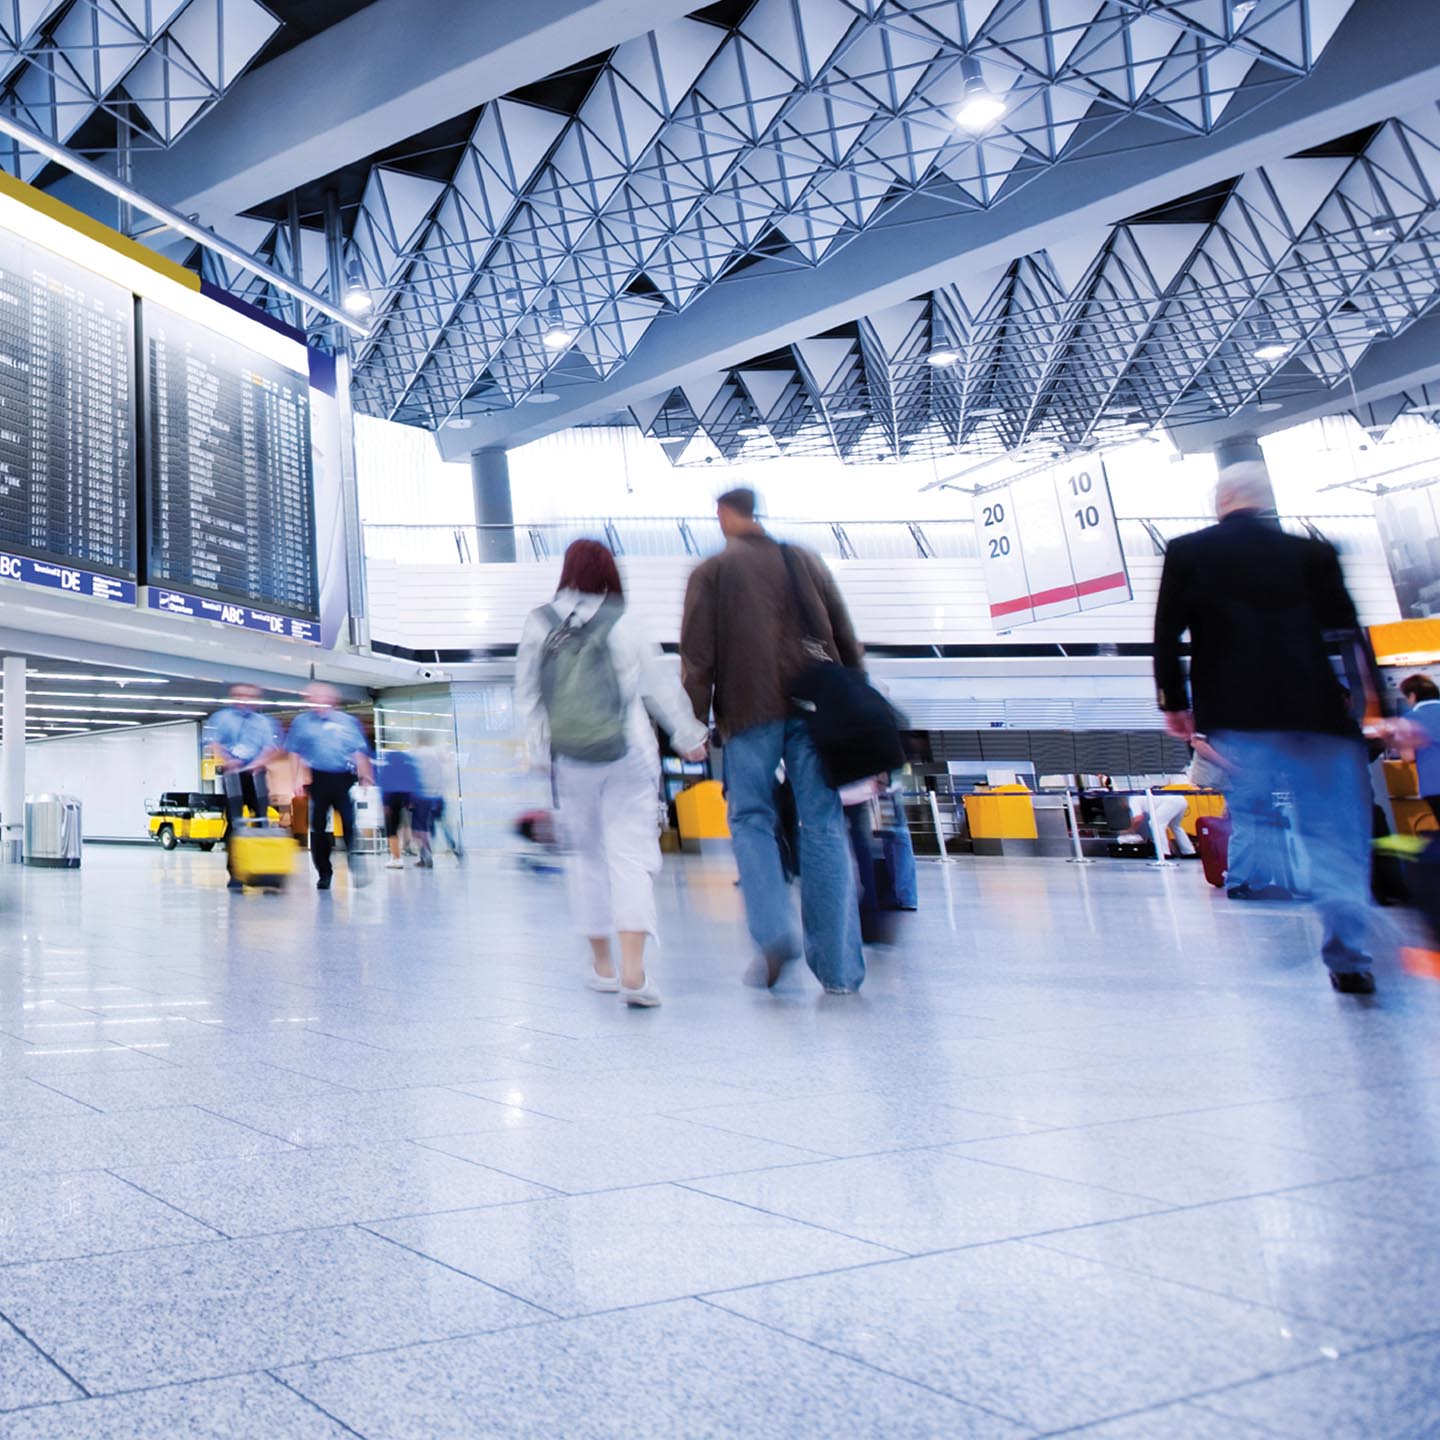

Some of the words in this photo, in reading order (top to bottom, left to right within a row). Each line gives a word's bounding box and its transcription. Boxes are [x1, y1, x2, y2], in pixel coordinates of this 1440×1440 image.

[1068, 472, 1092, 496] 10
[982, 503, 1004, 527] 20
[1074, 505, 1100, 530] 10
[988, 536, 1010, 559] 20
[60, 572, 81, 592] DE
[221, 605, 245, 626] ABC
[270, 616, 284, 634] DE
